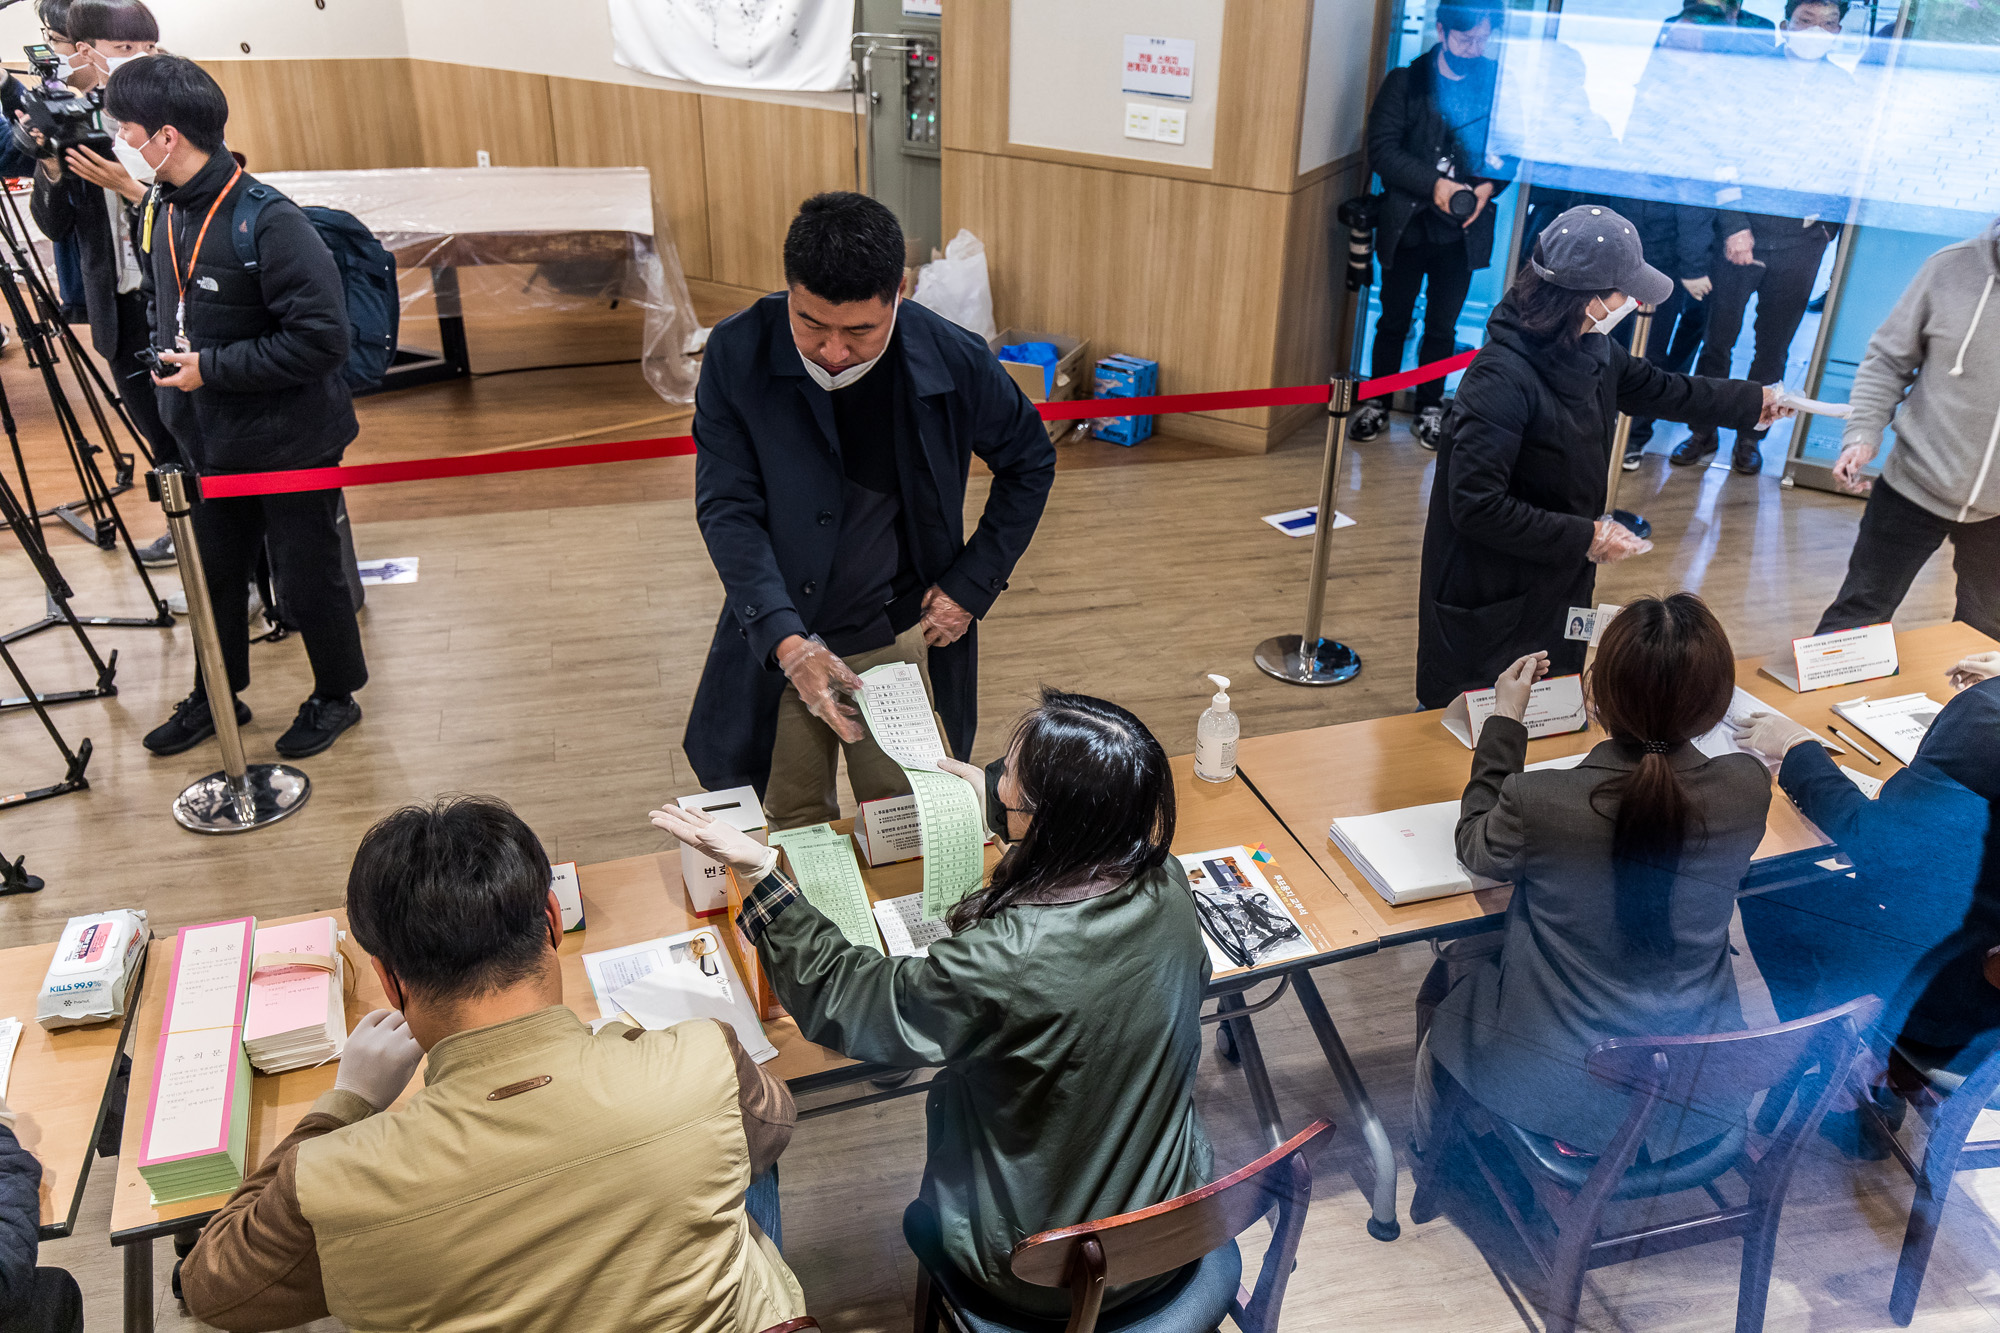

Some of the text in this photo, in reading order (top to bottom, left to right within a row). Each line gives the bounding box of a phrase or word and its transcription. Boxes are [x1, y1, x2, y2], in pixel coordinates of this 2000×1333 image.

[1273, 874, 1309, 916] 투표용지 교부석
[50, 983, 72, 993] KILLS
[74, 980, 101, 990] 99.9%
